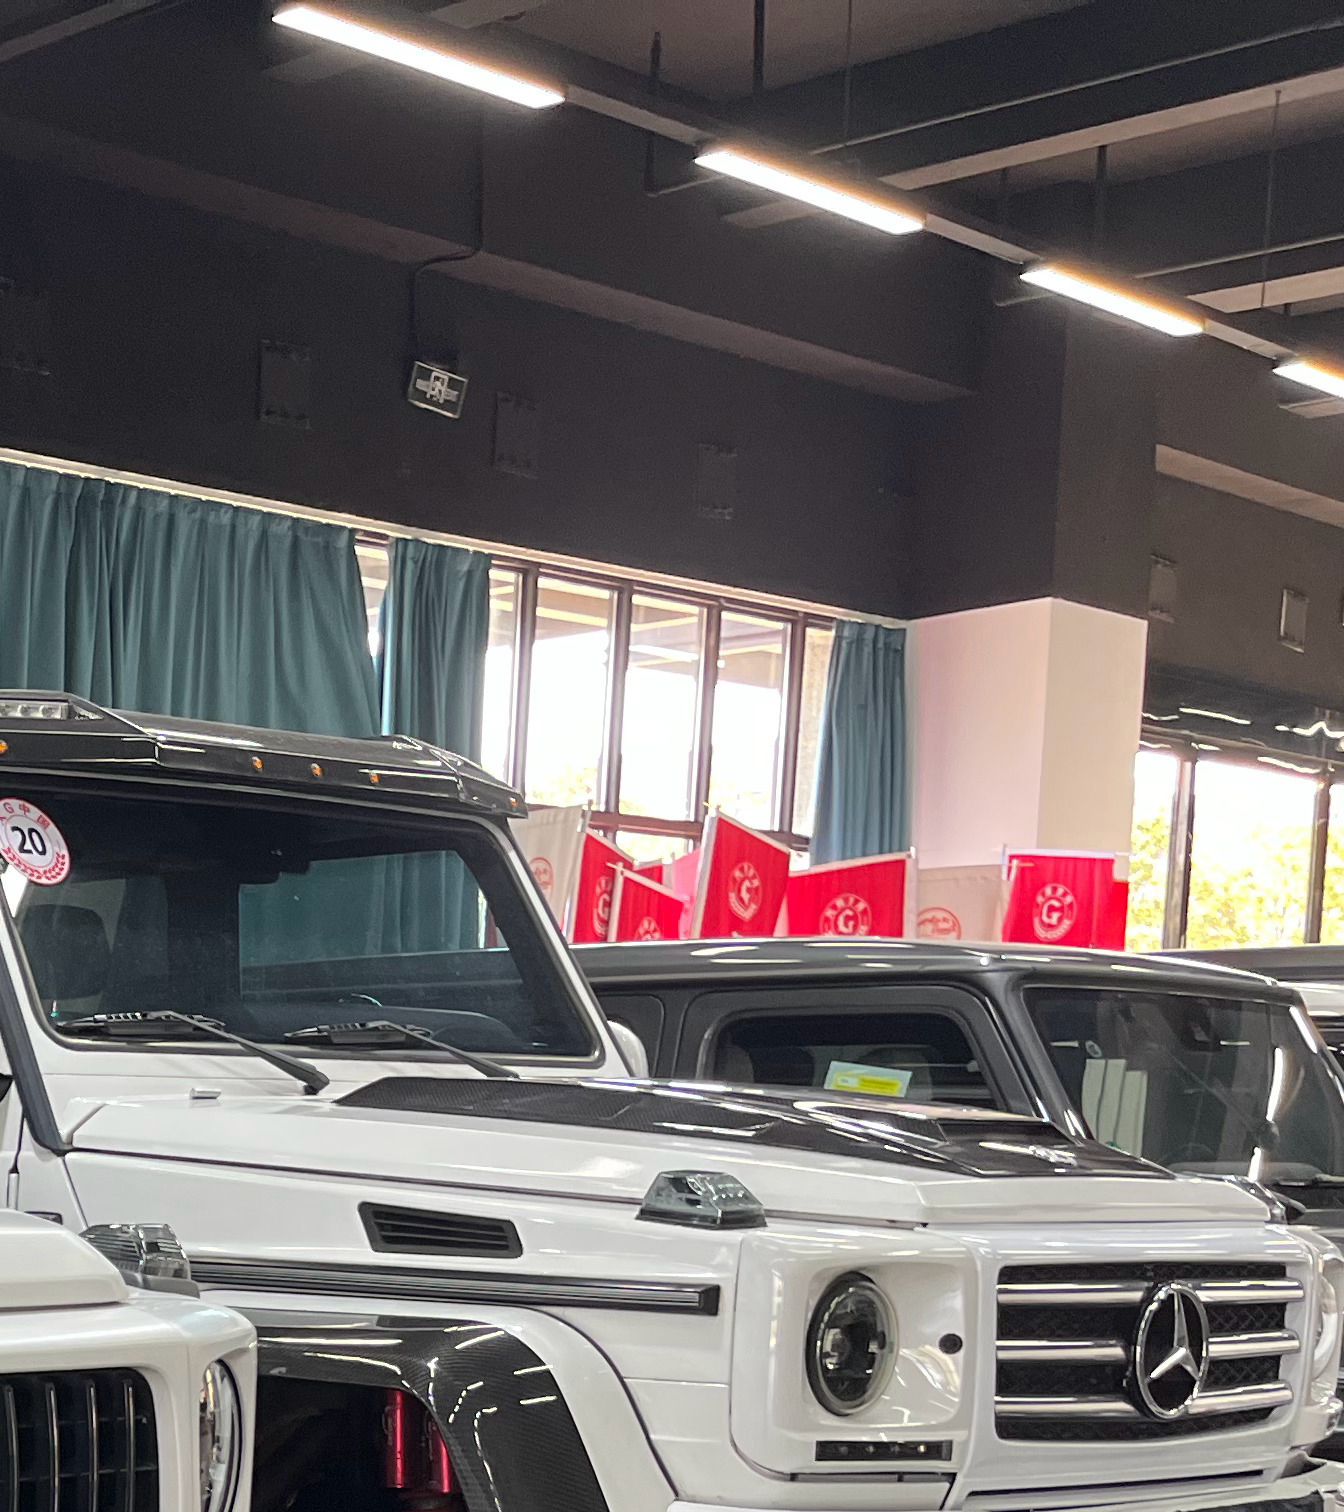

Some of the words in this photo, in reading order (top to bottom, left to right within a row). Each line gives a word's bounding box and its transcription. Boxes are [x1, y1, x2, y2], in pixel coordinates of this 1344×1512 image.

[11, 826, 47, 856] 20
[837, 908, 854, 934] G
[1041, 899, 1062, 925] G
